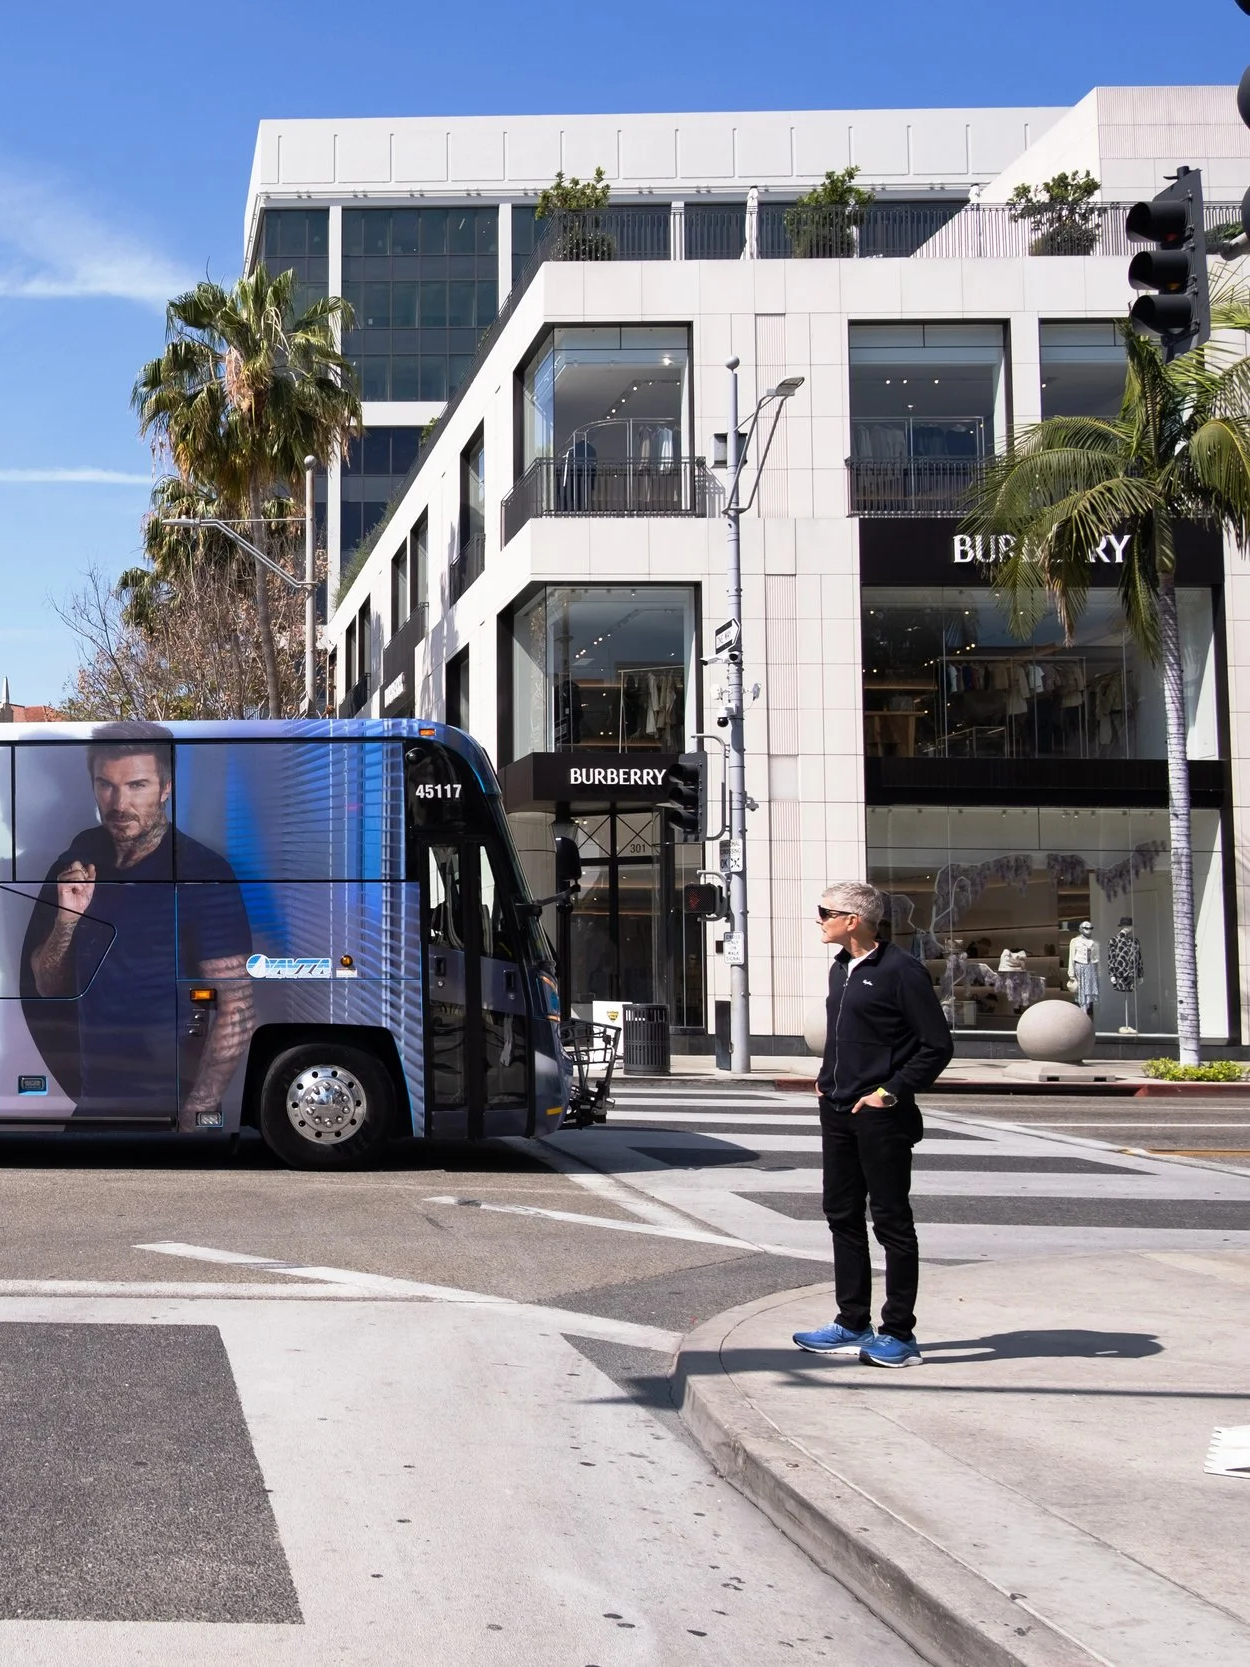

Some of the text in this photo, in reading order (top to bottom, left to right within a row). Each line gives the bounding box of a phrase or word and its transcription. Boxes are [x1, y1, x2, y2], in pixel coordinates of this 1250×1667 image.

[570, 767, 667, 785] BURBERRY
[415, 784, 462, 799] 45117
[630, 843, 646, 854] 301
